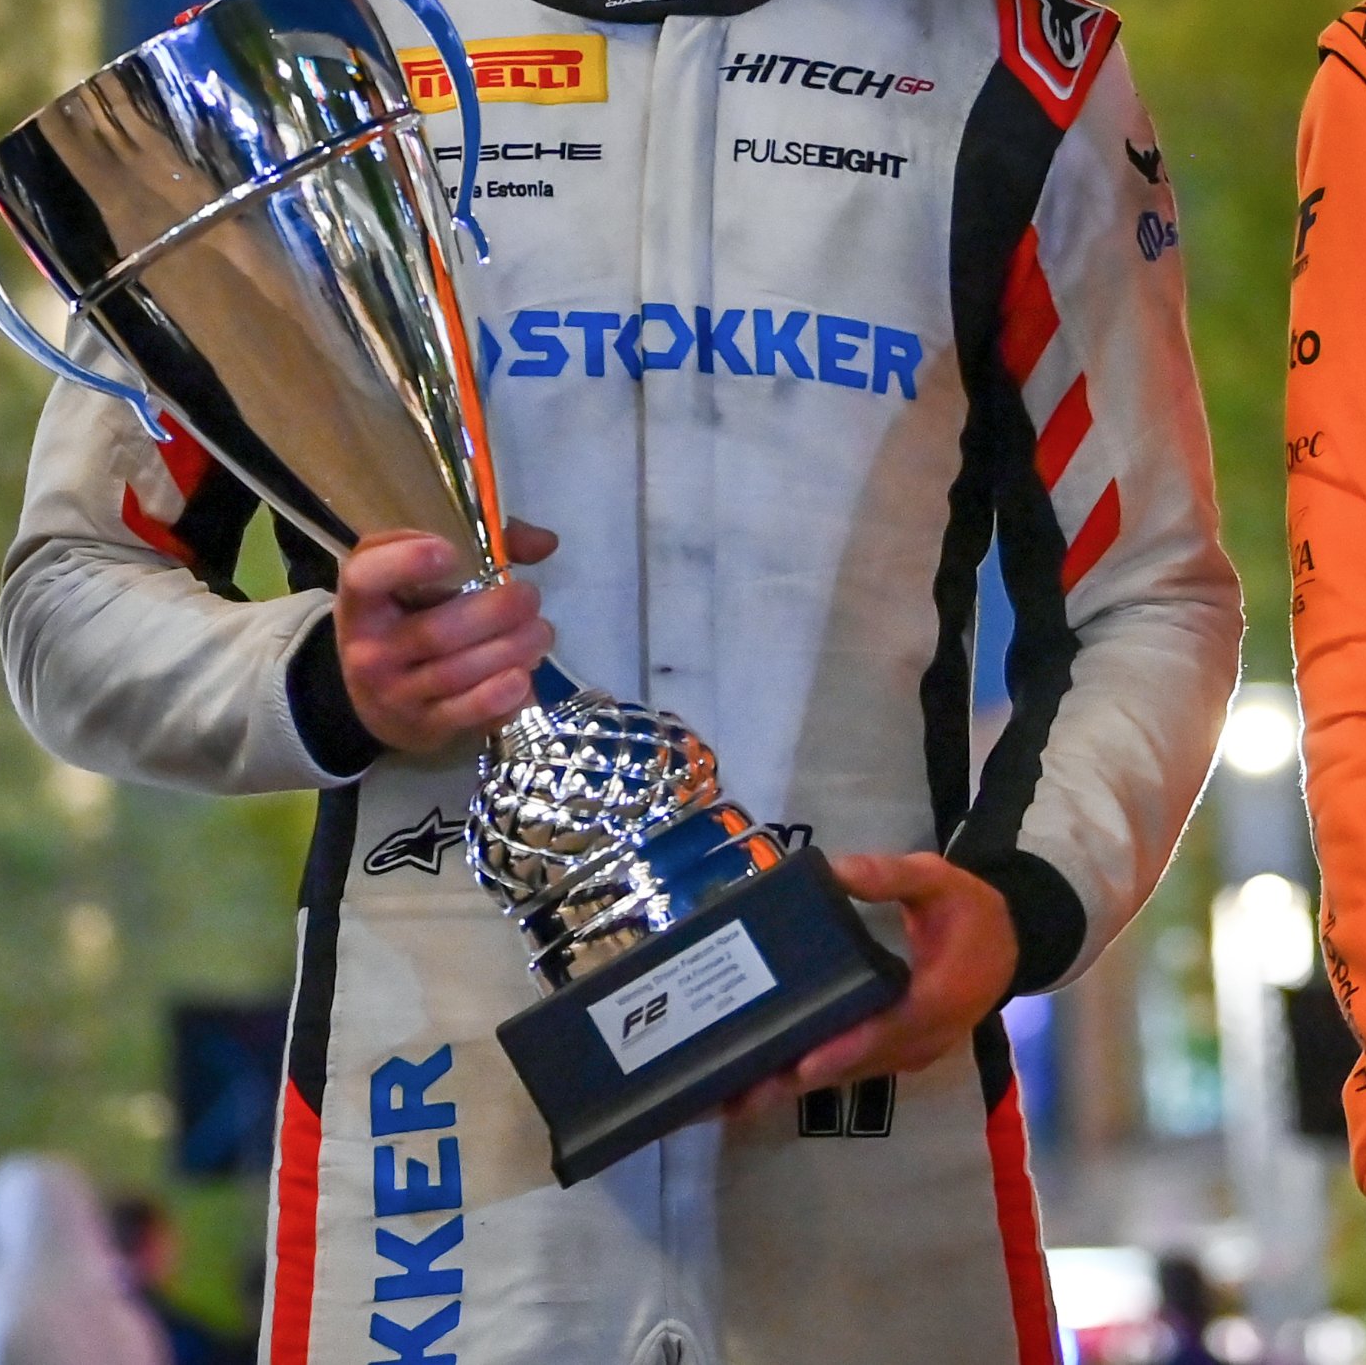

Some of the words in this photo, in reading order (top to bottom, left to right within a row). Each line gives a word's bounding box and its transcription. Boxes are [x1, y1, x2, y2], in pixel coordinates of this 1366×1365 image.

[719, 53, 896, 99] HITECH
[487, 180, 554, 198] Estonia
[507, 303, 924, 400] STOKKER
[622, 991, 669, 1040] F2
